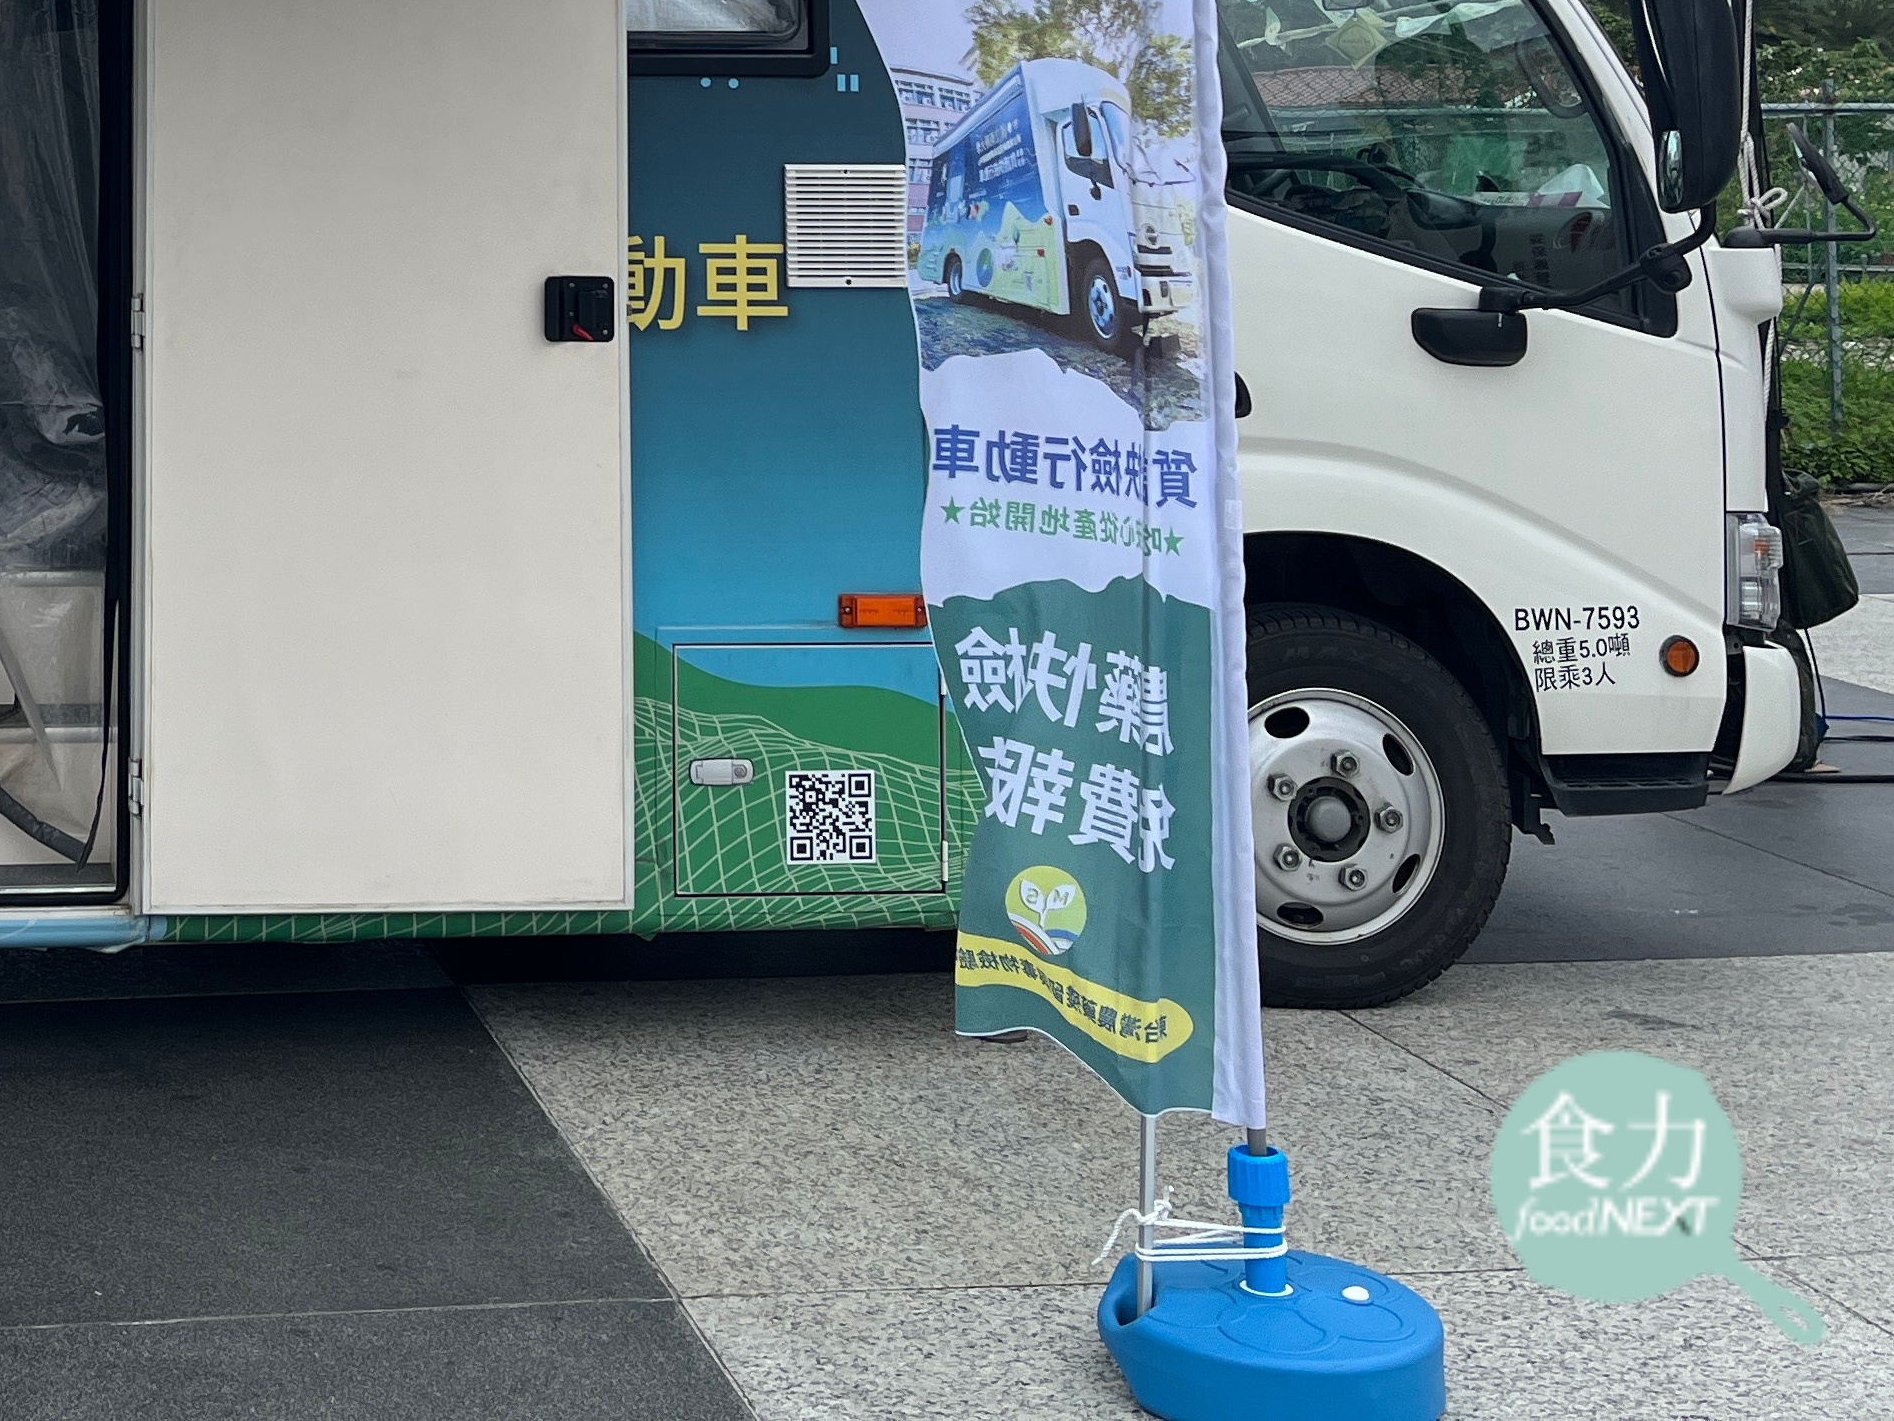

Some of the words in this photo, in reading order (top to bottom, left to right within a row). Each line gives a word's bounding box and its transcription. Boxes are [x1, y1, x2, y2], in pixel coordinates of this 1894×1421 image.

[1515, 605, 1640, 631] BWN-7593
[1532, 633, 1631, 665] 總重5.0噸
[1535, 662, 1616, 692] 限乘3人
